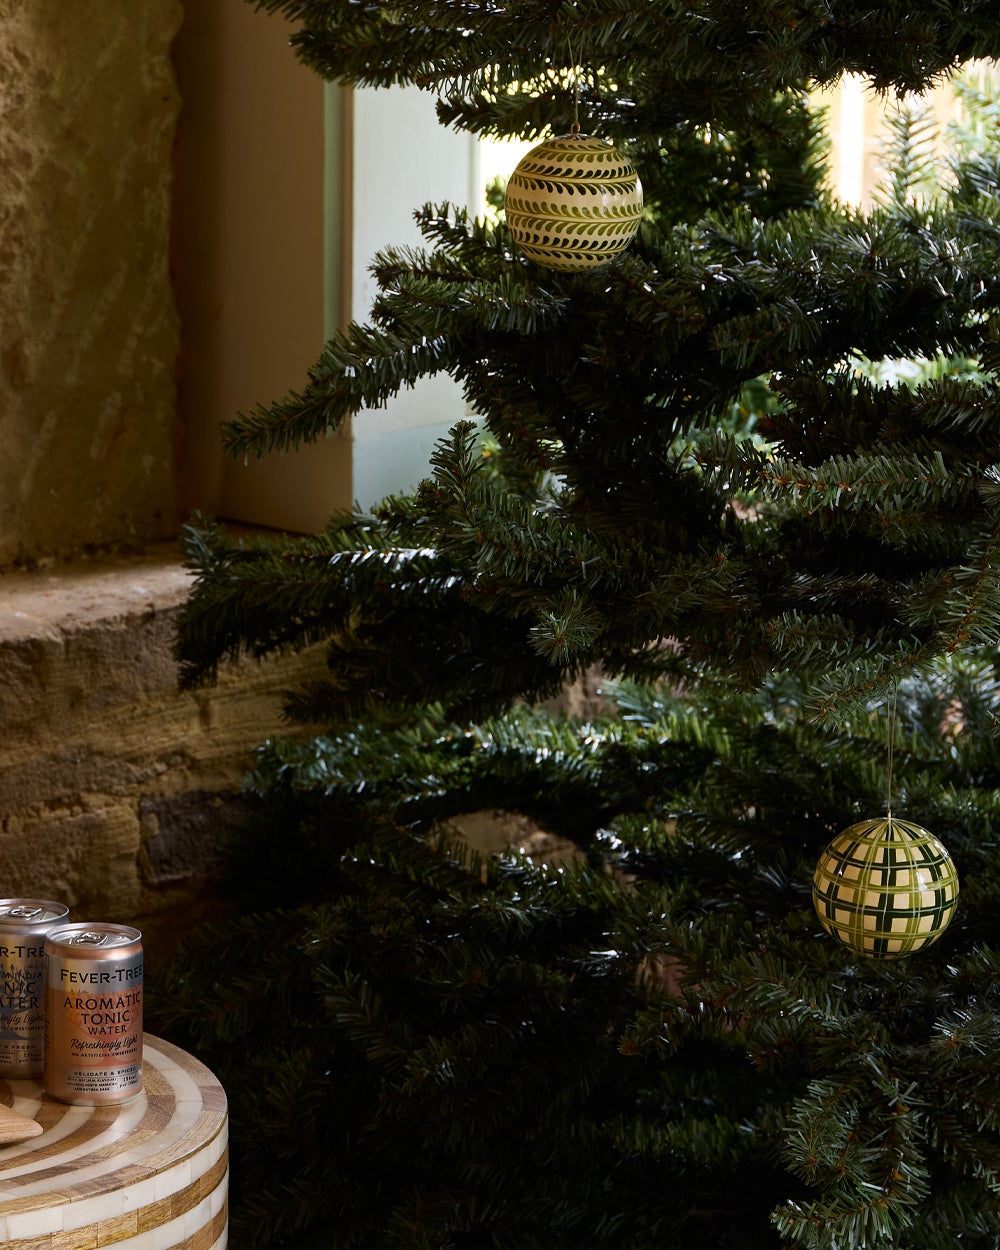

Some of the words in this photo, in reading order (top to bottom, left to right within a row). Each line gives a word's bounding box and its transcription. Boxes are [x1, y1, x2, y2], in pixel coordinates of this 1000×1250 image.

[60, 965, 143, 984] FEVER-TREE
[63, 991, 141, 1011] AROMATIC
[81, 1010, 131, 1025] TONIC
[87, 1024, 127, 1036] WATER
[70, 1038, 122, 1052] Refreshingly
